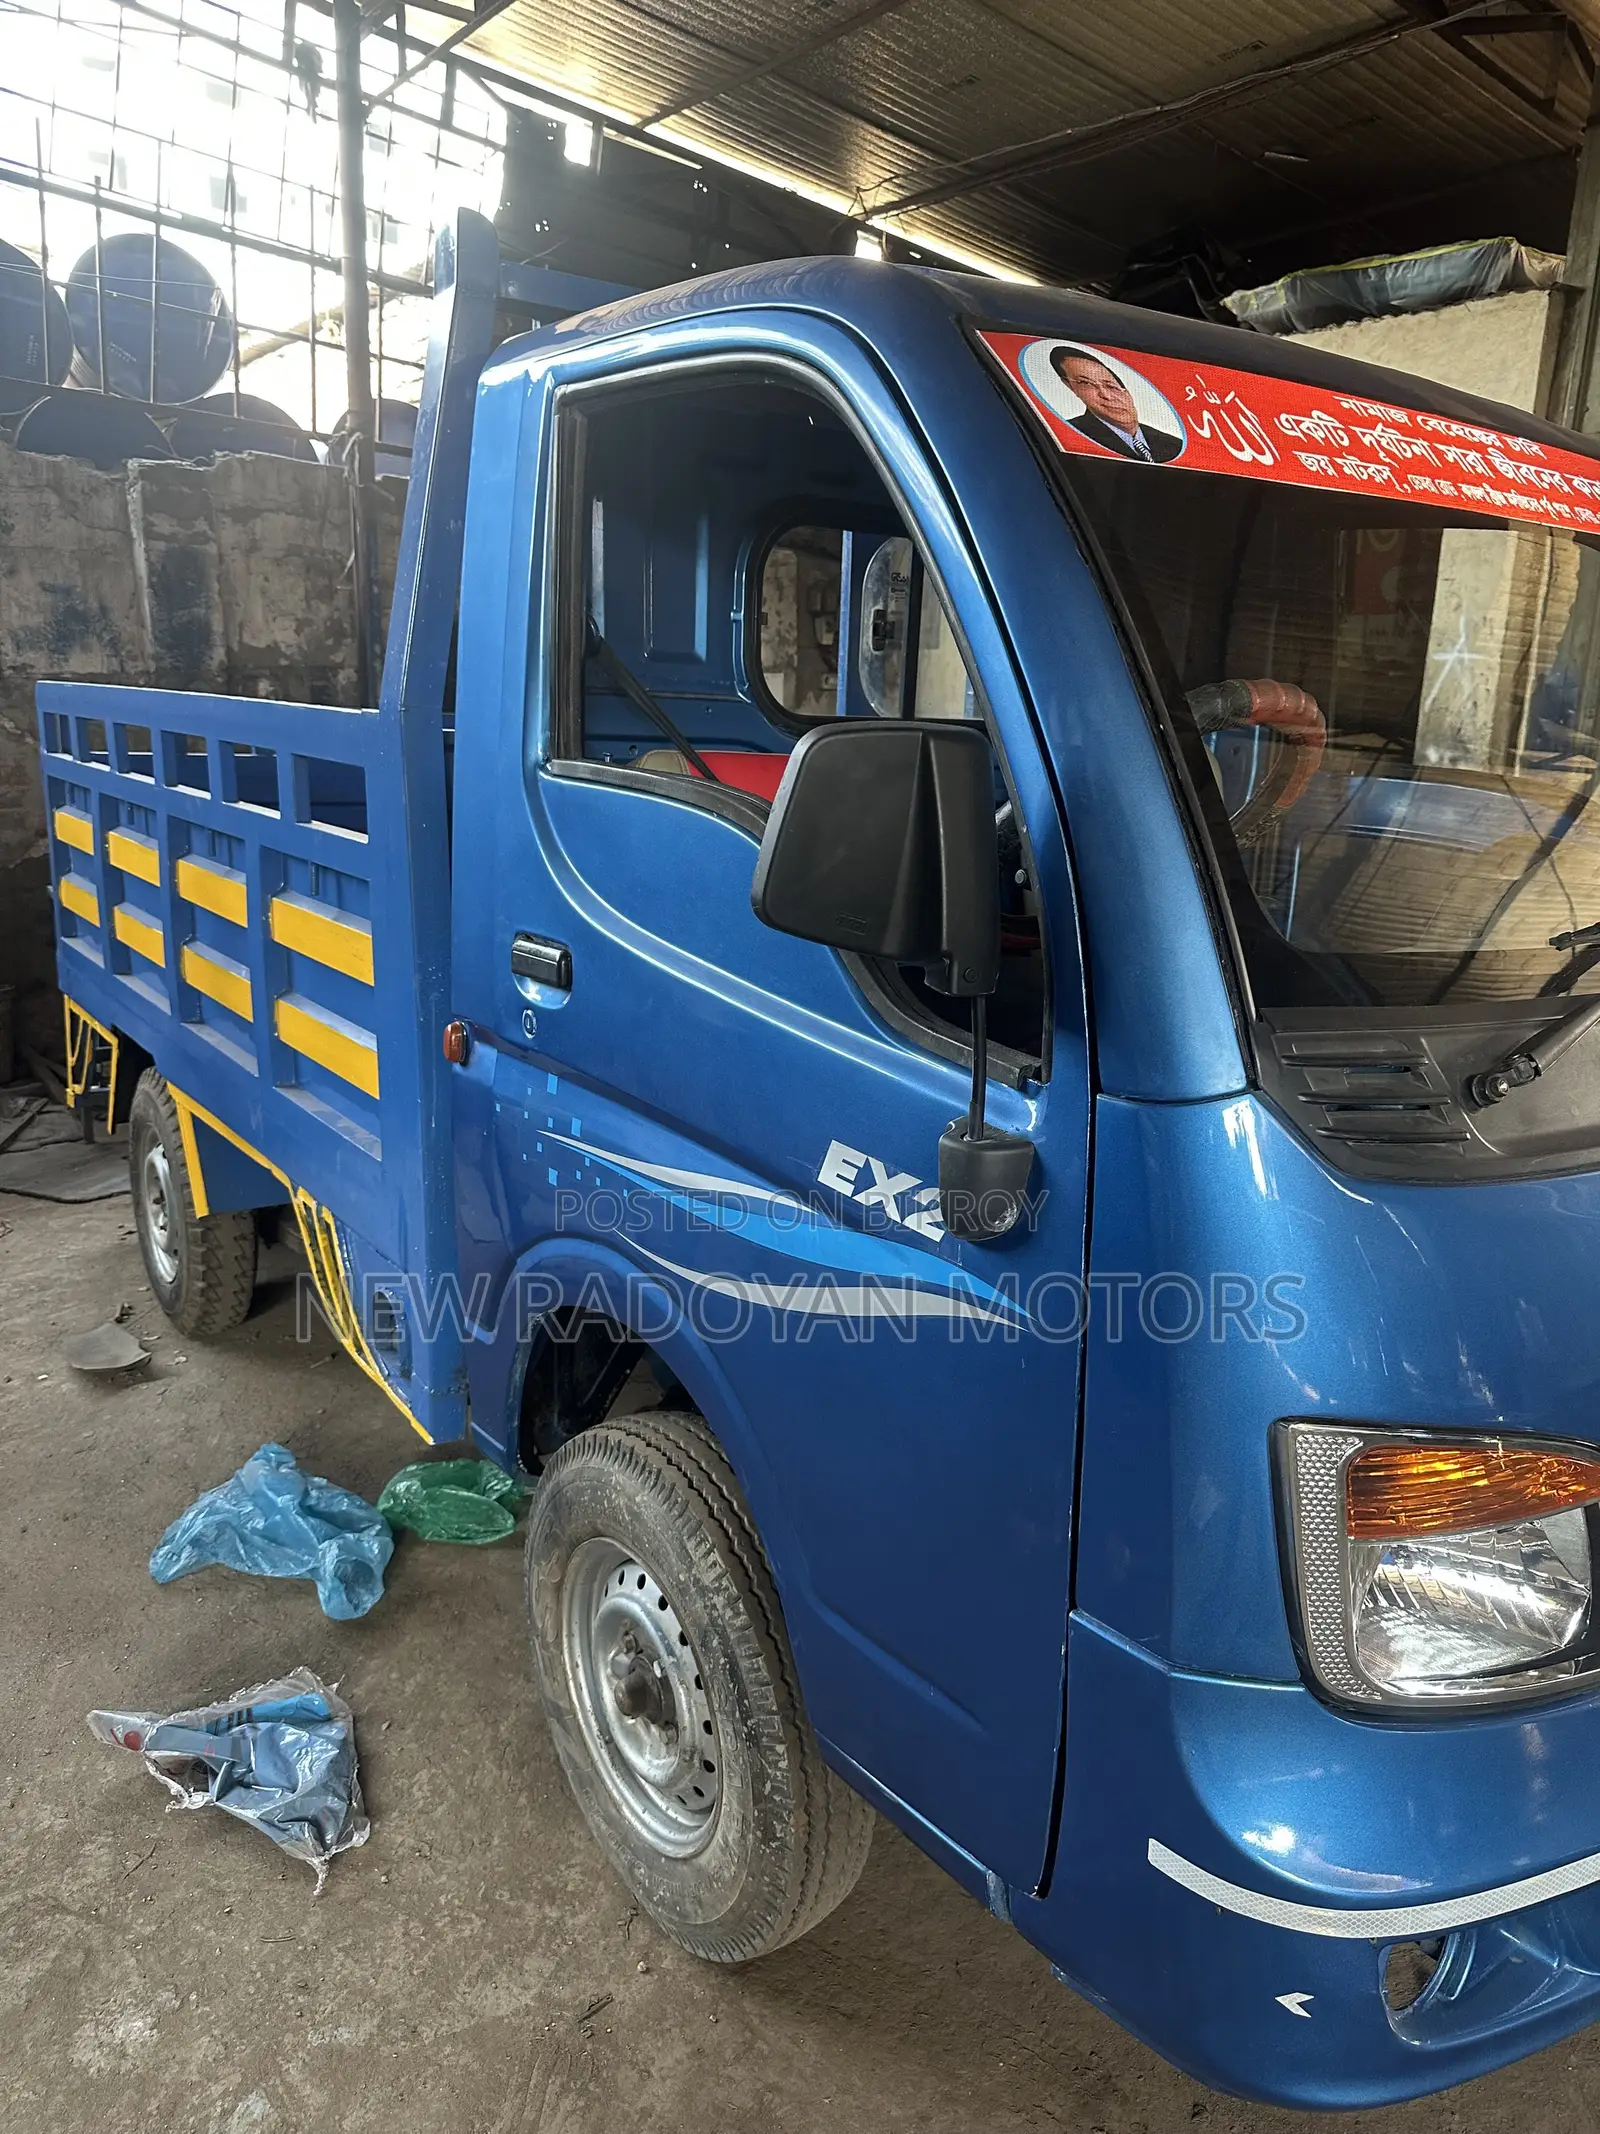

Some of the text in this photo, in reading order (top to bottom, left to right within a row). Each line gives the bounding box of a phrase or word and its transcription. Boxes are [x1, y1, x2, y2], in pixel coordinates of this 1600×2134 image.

[1273, 409, 1350, 448] একটি
[1433, 442, 1496, 479] সারা
[1485, 446, 1574, 496] জীবনের
[1332, 395, 1413, 427] নামাজ
[1501, 435, 1547, 460] চাবি
[1291, 450, 1339, 479] জয়
